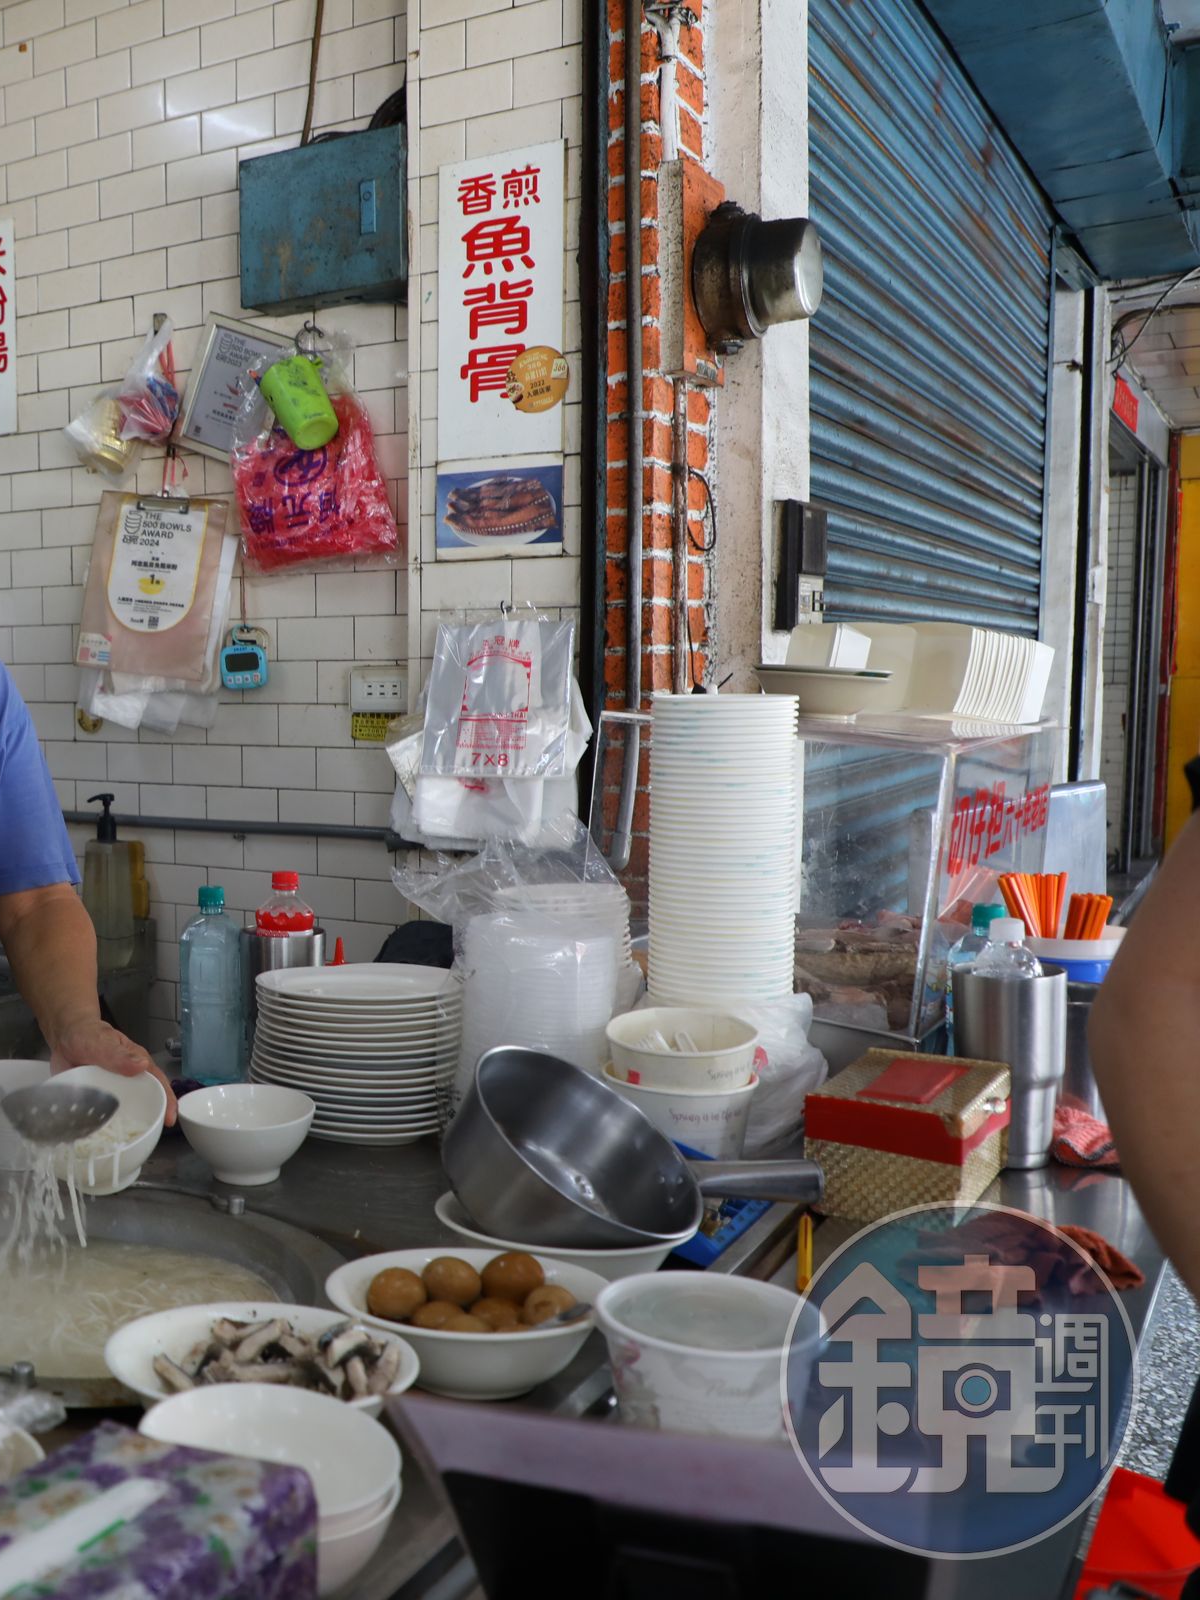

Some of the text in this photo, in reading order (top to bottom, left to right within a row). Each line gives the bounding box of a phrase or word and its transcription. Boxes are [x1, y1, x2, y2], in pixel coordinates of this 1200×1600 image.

[457, 165, 542, 216] 香煎
[460, 215, 536, 403] 魚背骨
[145, 511, 162, 520] THE
[142, 521, 192, 532] 500 BOWLS
[141, 529, 174, 539] AWARD
[140, 538, 160, 547] 2024
